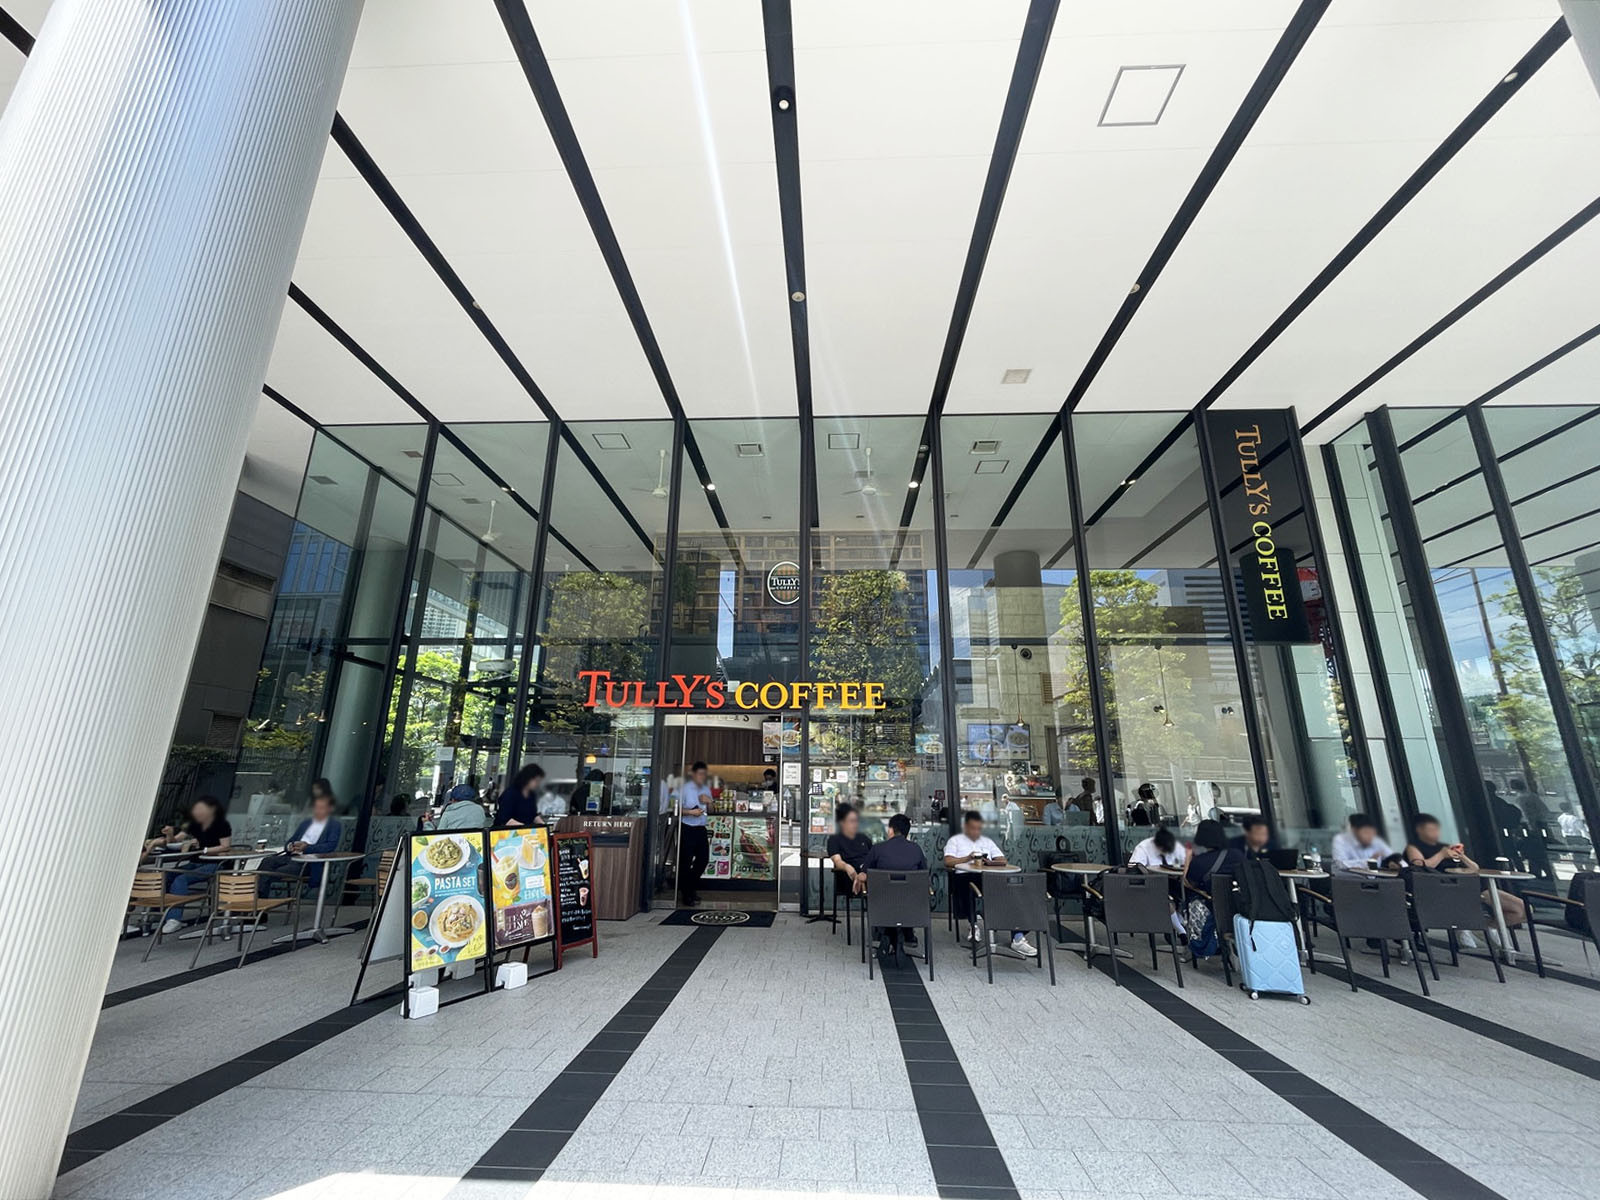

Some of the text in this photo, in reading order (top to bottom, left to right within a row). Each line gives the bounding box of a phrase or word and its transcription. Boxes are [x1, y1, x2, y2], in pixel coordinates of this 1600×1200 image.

[1234, 424, 1288, 621] TULLY'S COFFEE
[578, 670, 887, 710] TULLY'S COFFEE
[583, 820, 612, 828] RETURN
[434, 876, 476, 890] PASTA SET
